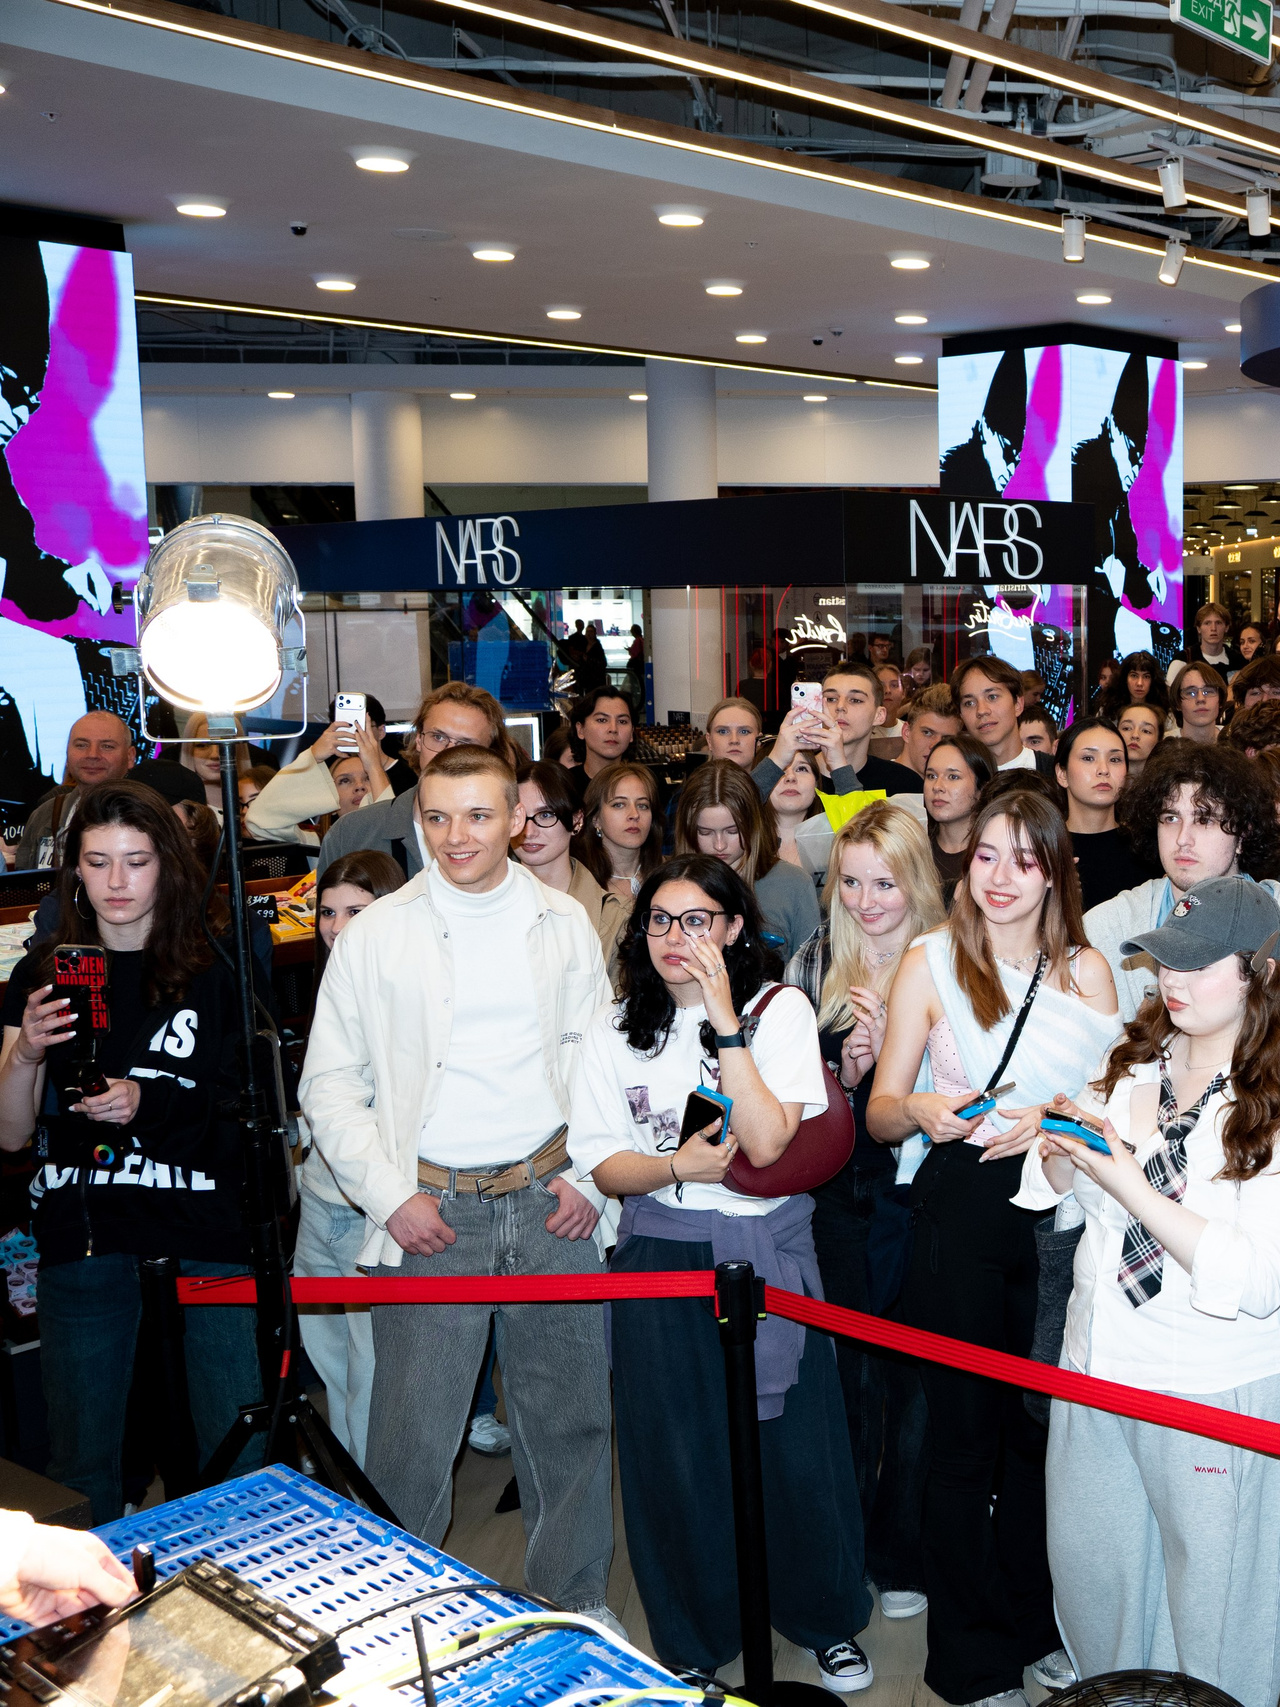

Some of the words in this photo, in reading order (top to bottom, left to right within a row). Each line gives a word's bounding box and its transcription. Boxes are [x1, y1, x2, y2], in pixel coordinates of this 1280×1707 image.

[1191, 0, 1215, 21] EXIT
[436, 515, 521, 585] NARS
[910, 499, 1044, 580] NARS
[54, 956, 104, 974] WMEN
[1194, 1465, 1228, 1475] WAWILA
